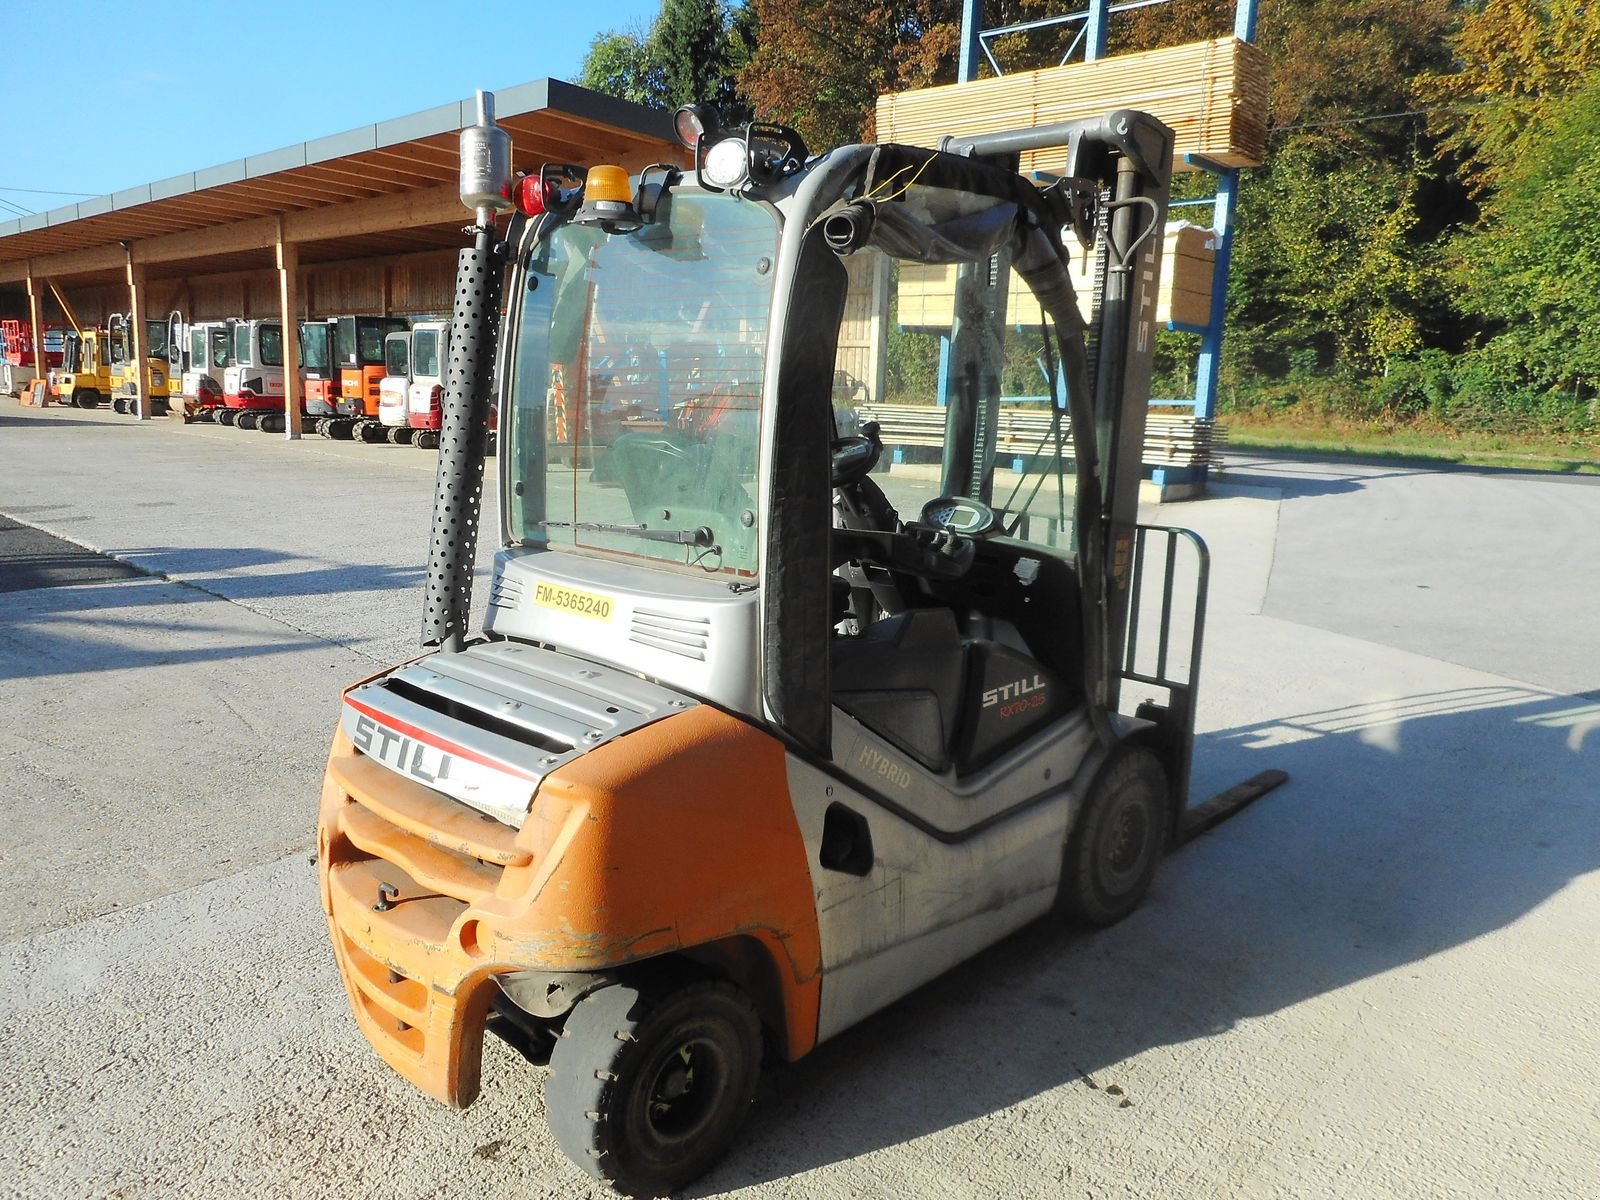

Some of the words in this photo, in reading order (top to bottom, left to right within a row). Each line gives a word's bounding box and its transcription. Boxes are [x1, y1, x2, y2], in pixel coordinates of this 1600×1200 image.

[535, 584, 610, 618] FM-5365240
[982, 674, 1046, 708] STILL
[999, 692, 1047, 720] RX70-25
[858, 745, 911, 790] HYBRID
